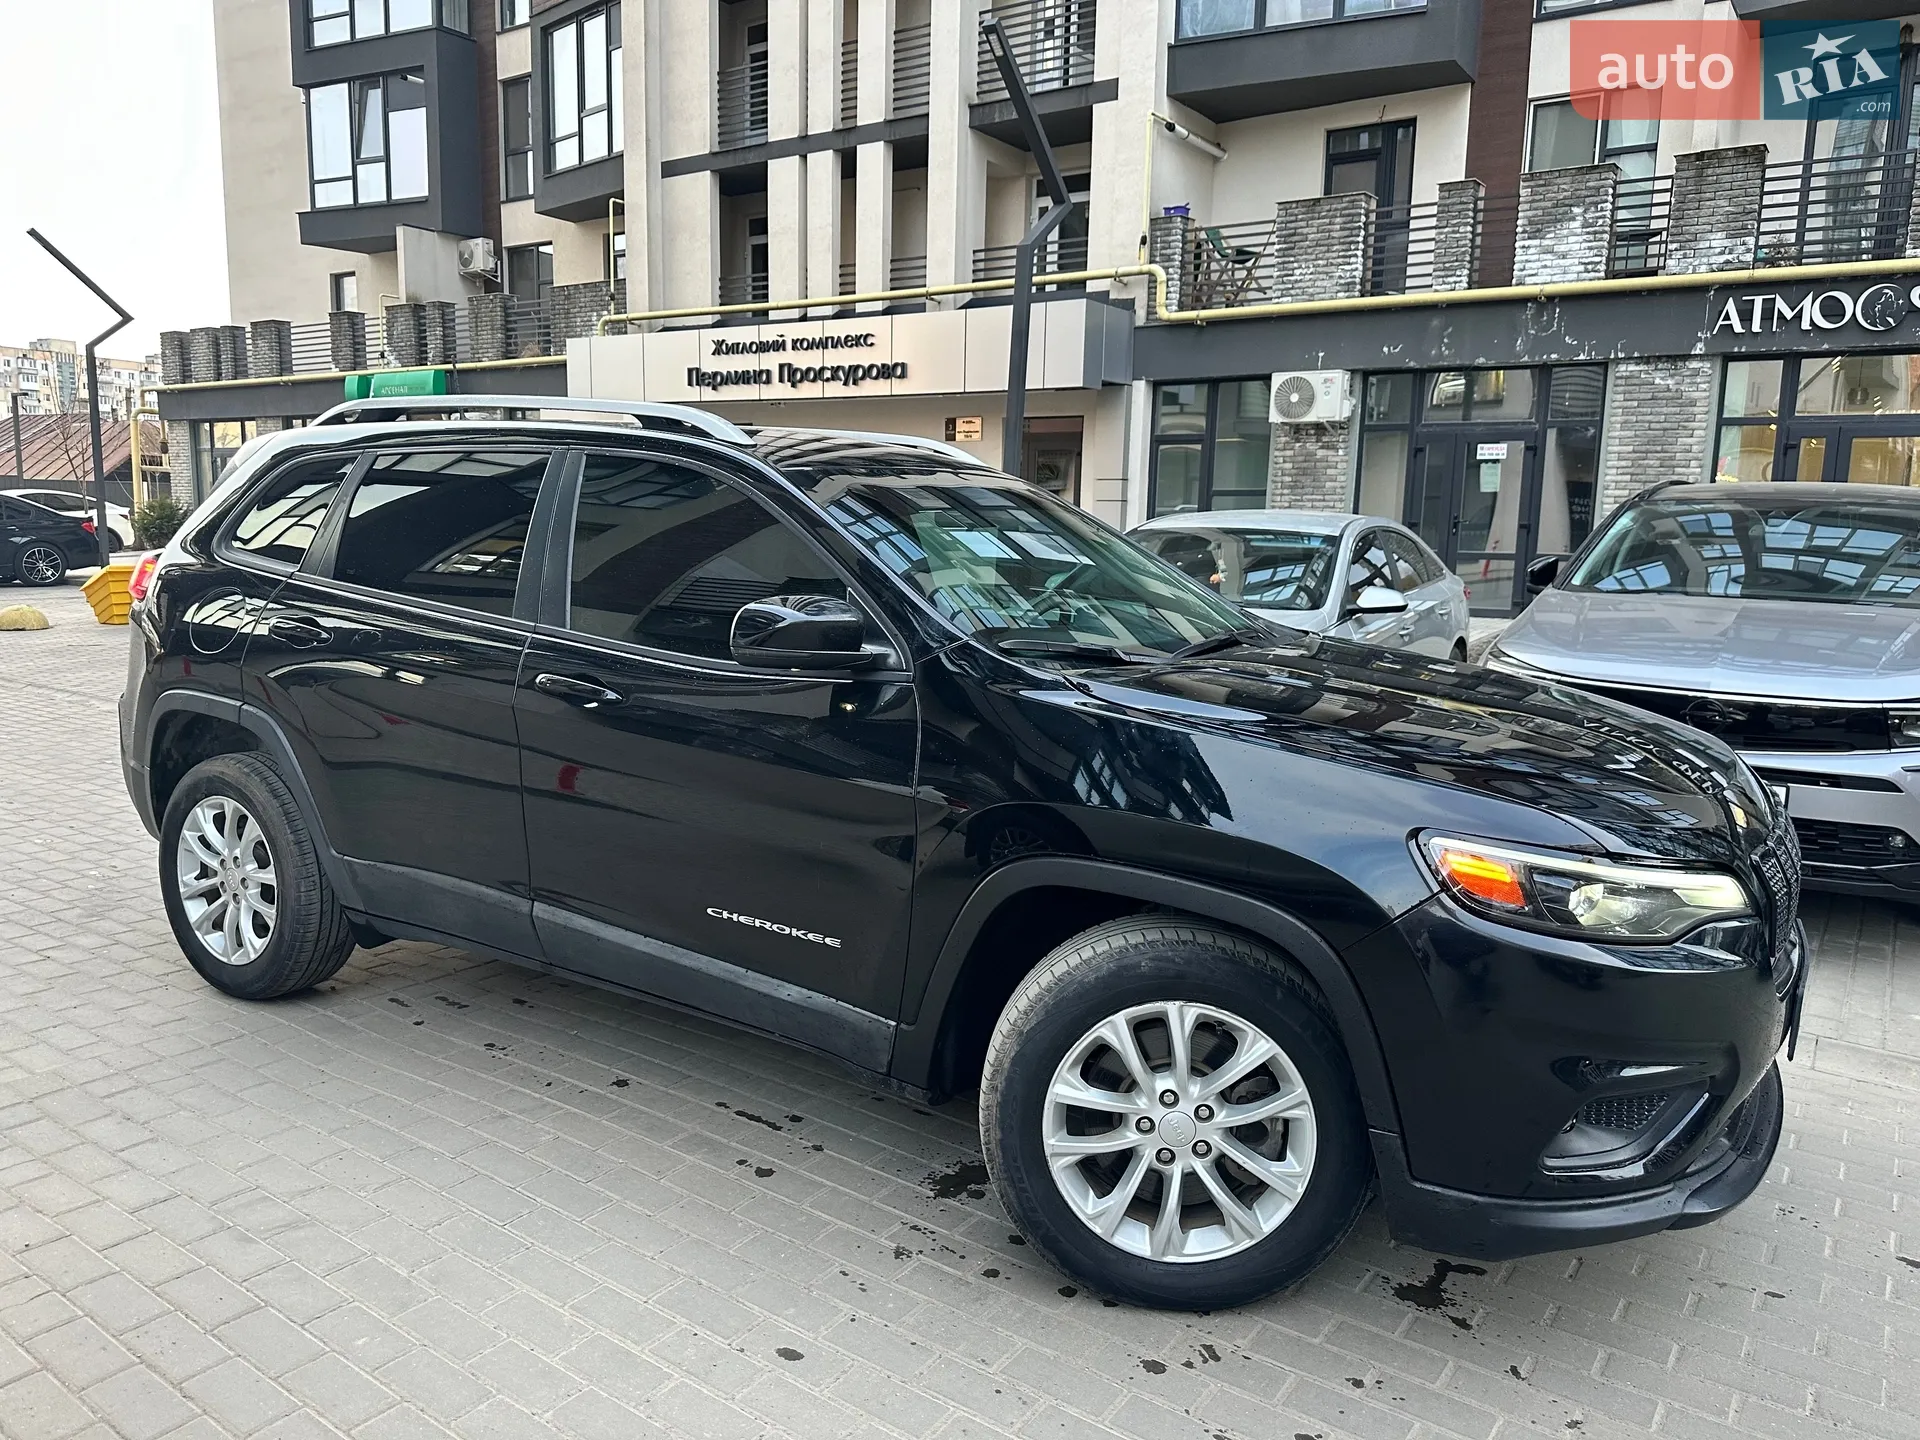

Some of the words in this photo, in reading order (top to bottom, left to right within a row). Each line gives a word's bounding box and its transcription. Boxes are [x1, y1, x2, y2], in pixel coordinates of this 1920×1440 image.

[1713, 283, 1920, 335] АТМОС
[711, 334, 787, 356] Житловий
[791, 332, 875, 352] комплекс
[687, 367, 772, 391] Перлина
[778, 362, 908, 388] Проскурова
[706, 907, 842, 949] CHEROKEE
[1168, 1118, 1186, 1142] Jeep
